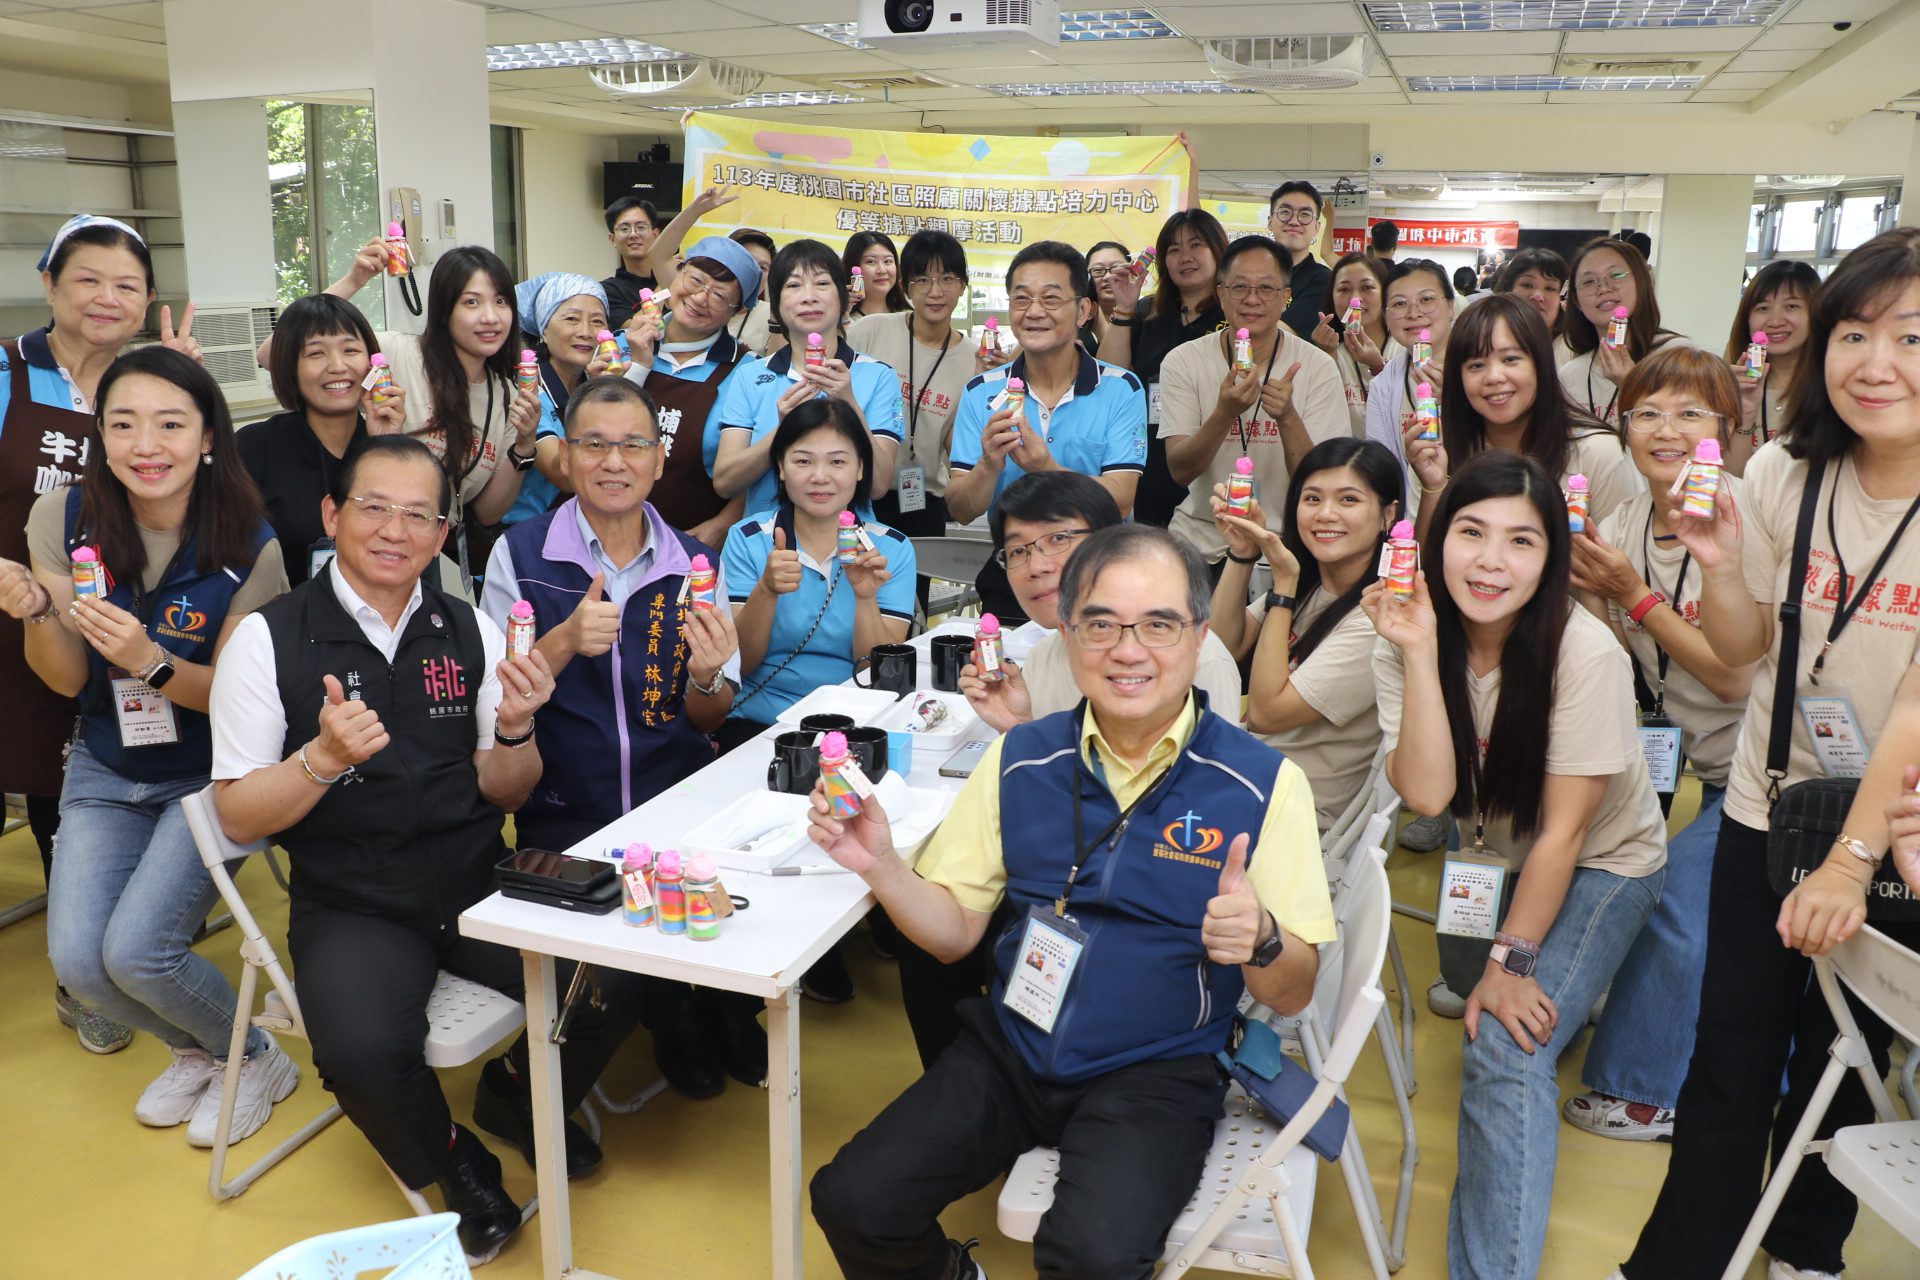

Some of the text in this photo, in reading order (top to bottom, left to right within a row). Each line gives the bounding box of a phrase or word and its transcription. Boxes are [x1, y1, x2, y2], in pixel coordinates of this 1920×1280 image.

[713, 164, 1159, 214] 113年度桃園市社區照顧關懷據點培力中心
[34, 464, 85, 494] 咖
[641, 592, 666, 727] 專門委員 林坤宗
[429, 705, 469, 715] 桃園市政府
